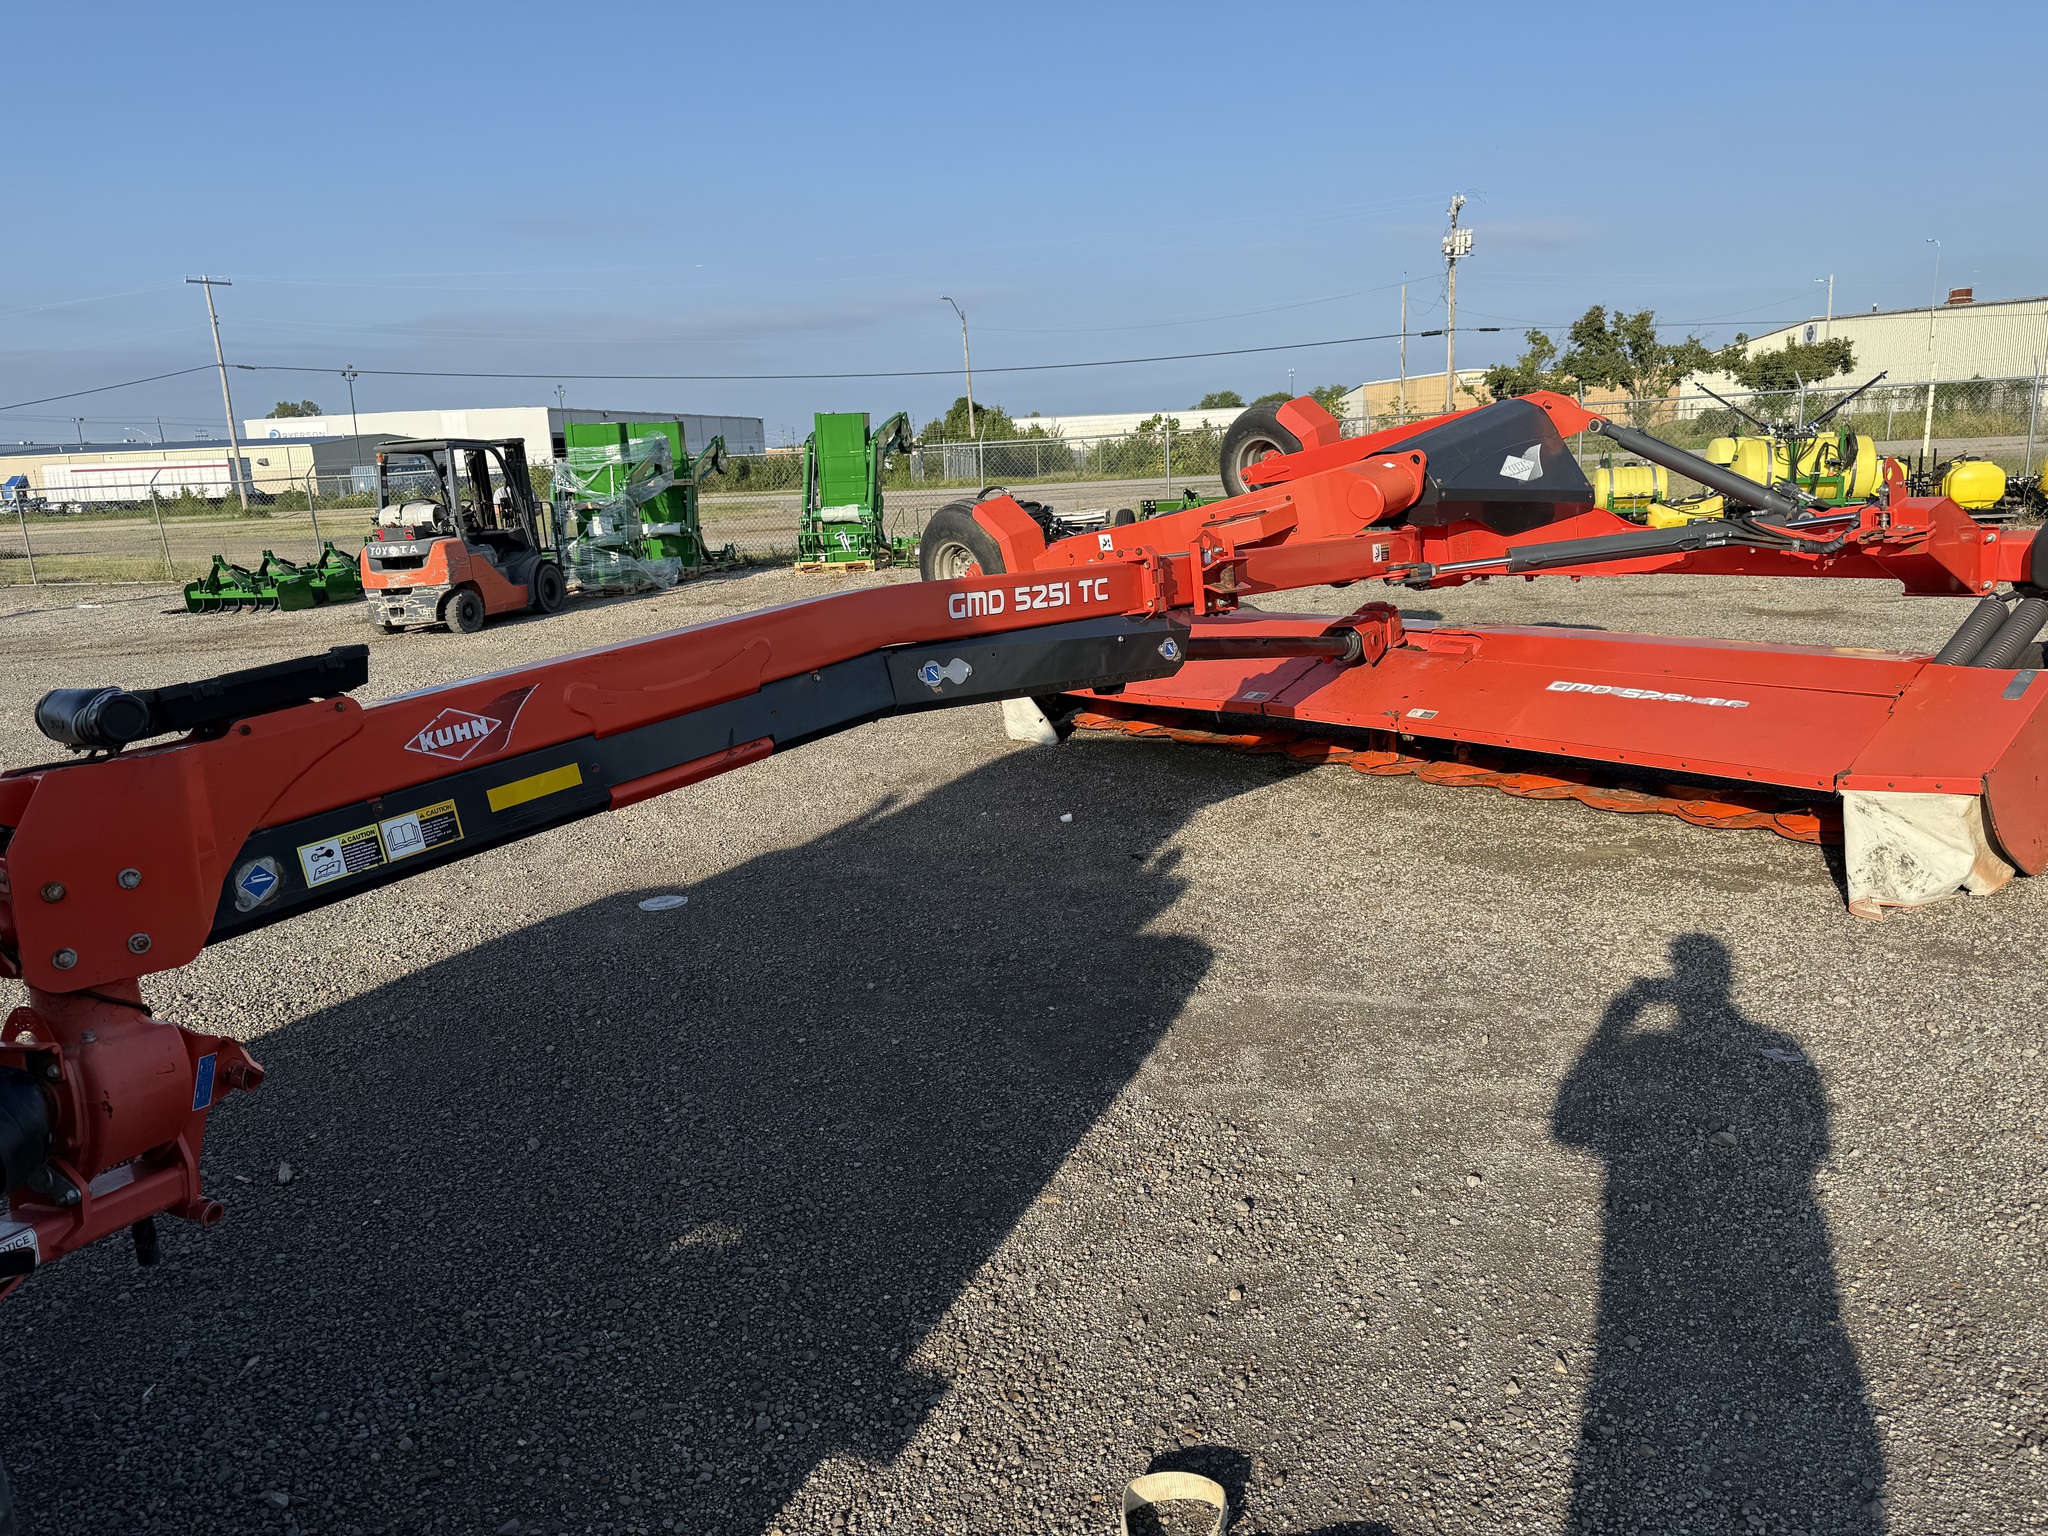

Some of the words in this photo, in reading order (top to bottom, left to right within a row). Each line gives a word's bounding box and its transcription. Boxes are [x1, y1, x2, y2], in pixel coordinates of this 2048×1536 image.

[369, 545, 418, 555] TOYOTA
[948, 589, 1005, 619] GMD
[1015, 581, 1070, 612] 5251
[1078, 577, 1109, 604] TC
[1546, 680, 1613, 694] GMD
[418, 717, 490, 753] KUHN
[425, 803, 453, 817] CAUTION
[346, 828, 377, 843] CAUTION
